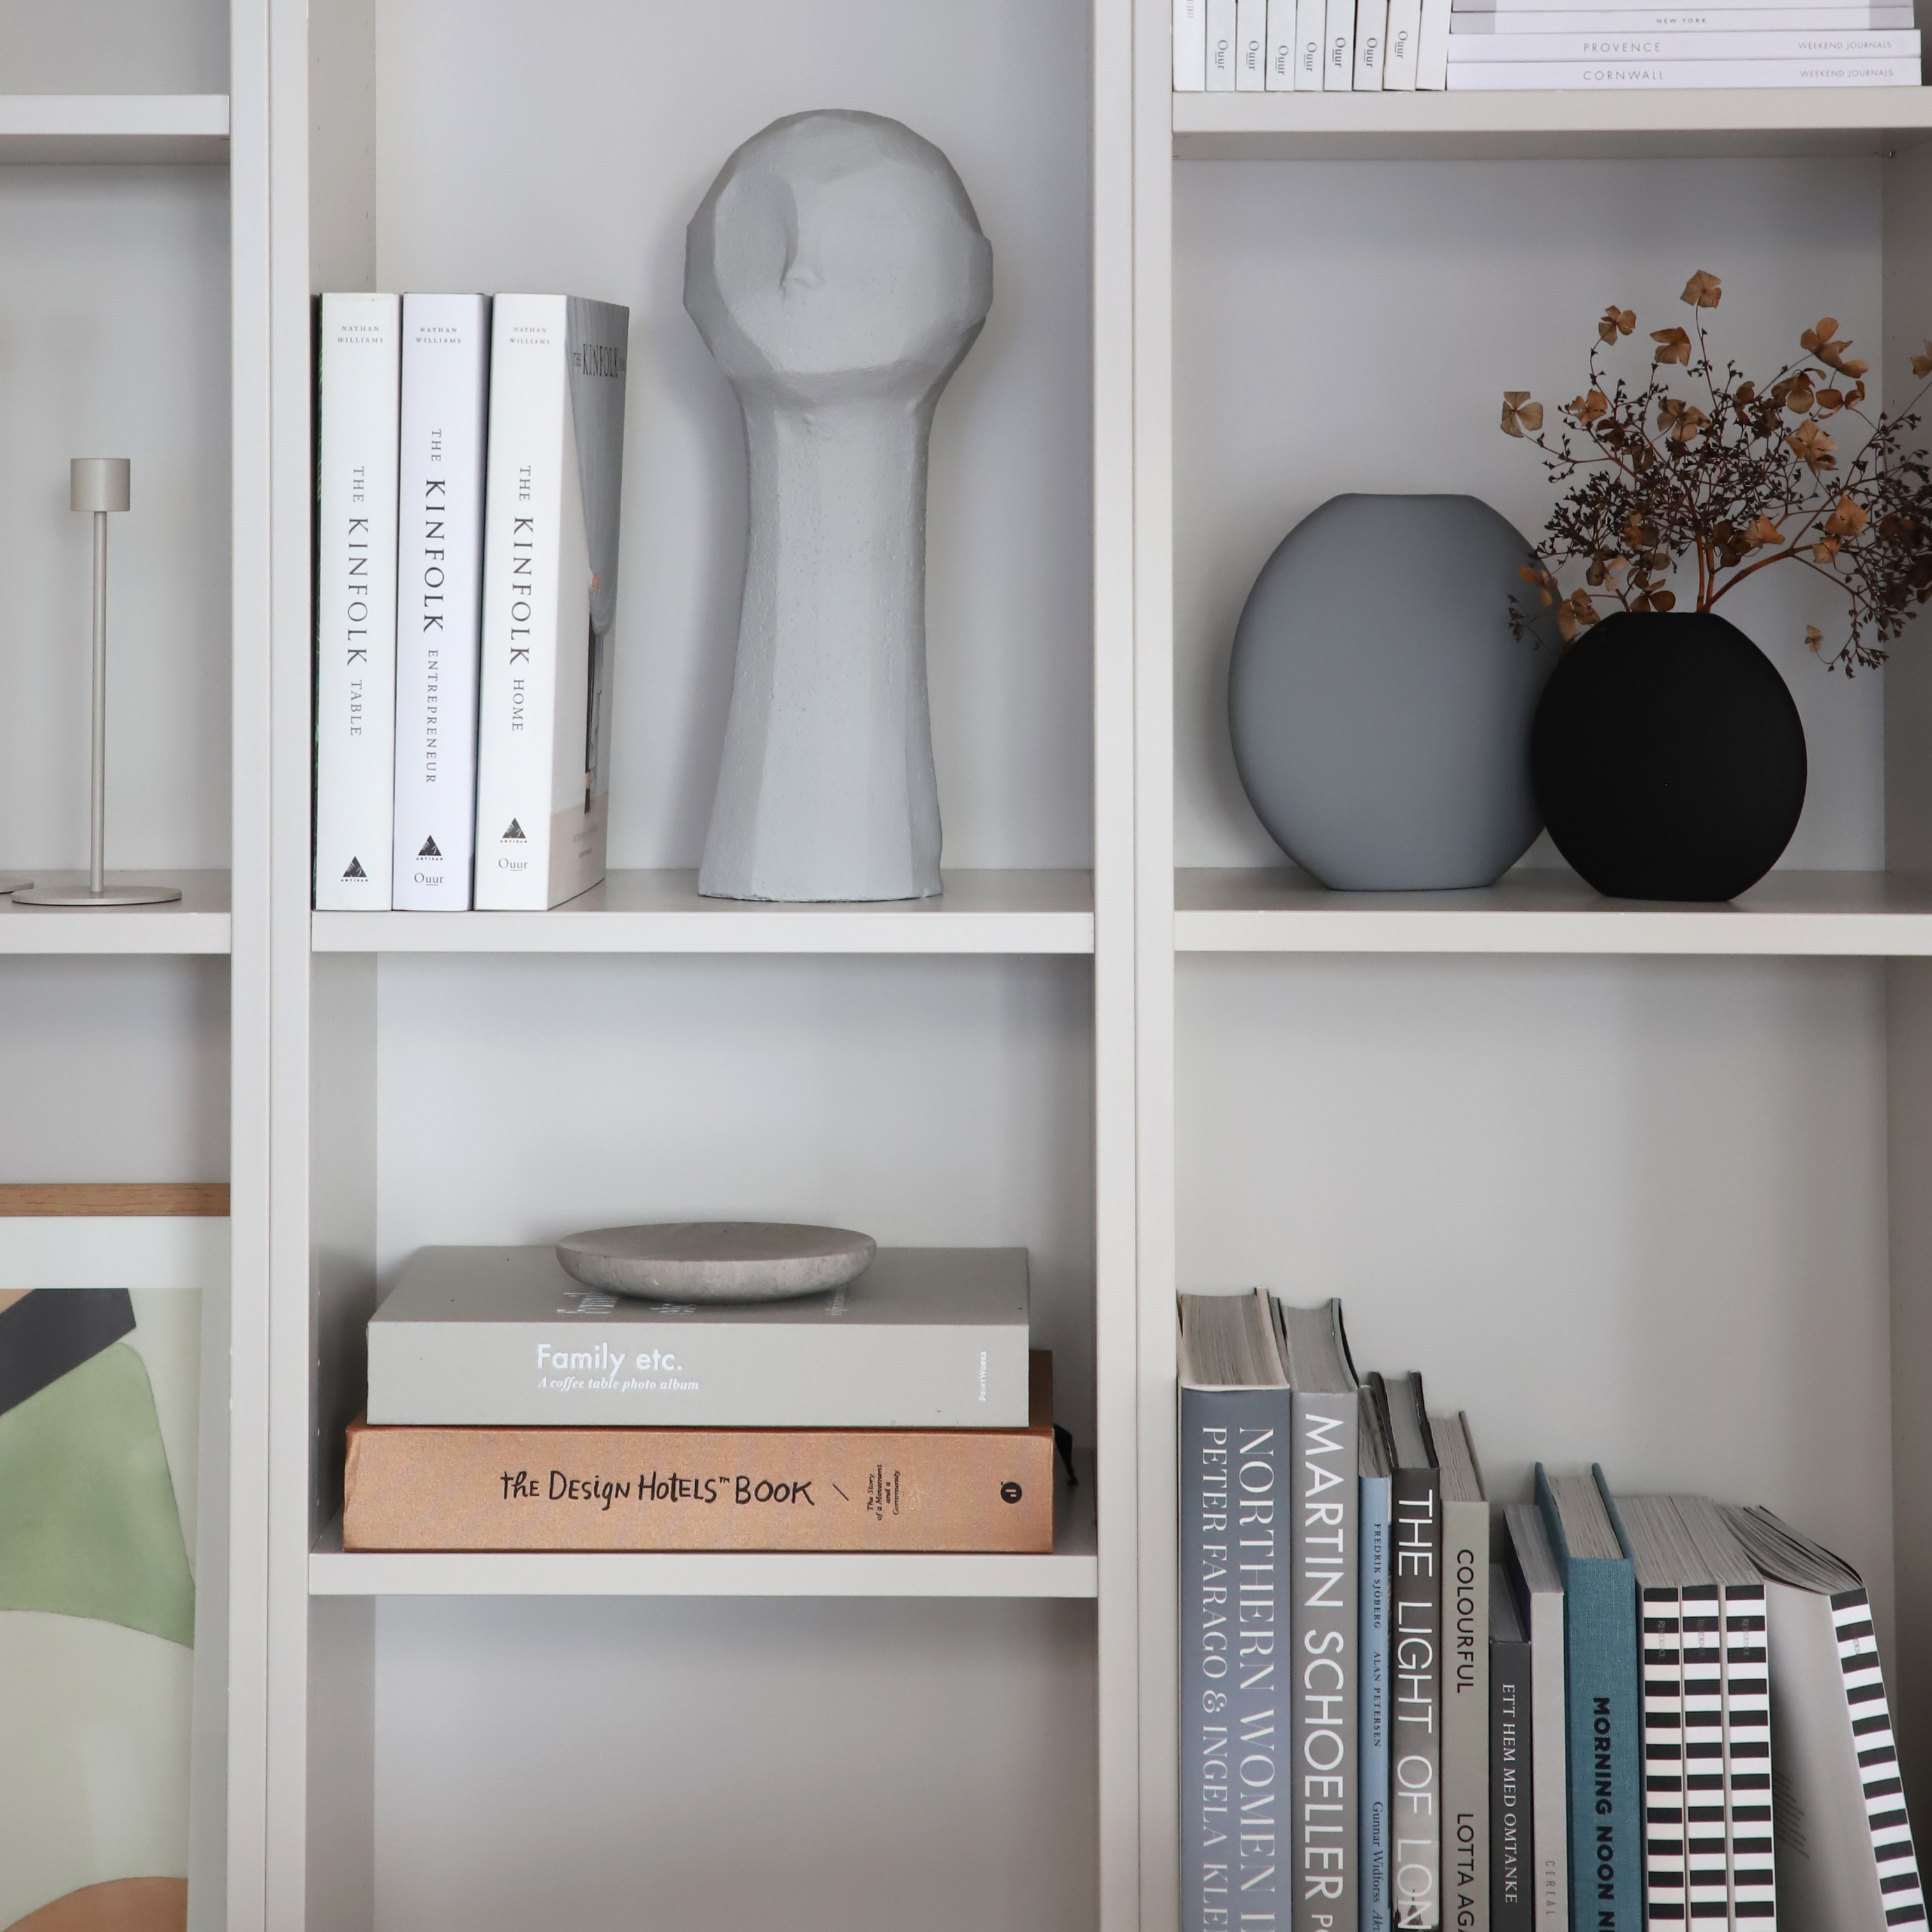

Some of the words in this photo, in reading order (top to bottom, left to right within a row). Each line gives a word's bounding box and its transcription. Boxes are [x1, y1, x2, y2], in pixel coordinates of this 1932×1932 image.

[1215, 40, 1228, 70] Ouur
[1246, 40, 1259, 70] Ouur
[1276, 45, 1289, 75] Ouur
[1304, 42, 1317, 73] Ouur
[1332, 37, 1346, 68] Ouur
[1364, 38, 1378, 68] Ouur
[1395, 31, 1409, 59] Ouur
[1584, 43, 1660, 52] PROVENCE
[1846, 41, 1892, 50] JOURNALS
[1583, 71, 1663, 80] CORNWALL
[1800, 69, 1845, 77] WEEKEND
[1848, 69, 1894, 77] JOURNALS
[583, 343, 618, 378] KINFOLK
[431, 429, 441, 461] THE
[353, 466, 364, 502] THE
[519, 466, 530, 500] THE
[422, 479, 446, 634] KINFOLK
[346, 517, 369, 667] KINFOLK
[509, 517, 535, 666] KINFOLK
[351, 680, 362, 736] TABLE
[426, 651, 438, 782] ENTREPRENEUR
[512, 679, 524, 731] HOME
[414, 873, 444, 886] Ouur
[498, 859, 528, 871] Ouur
[537, 1343, 626, 1377] Family
[636, 1349, 683, 1371] etc.
[538, 1378, 547, 1388] A
[550, 1377, 584, 1391] coffee
[588, 1377, 619, 1390] table
[622, 1379, 657, 1392] photo
[660, 1379, 699, 1390] album
[736, 1476, 815, 1506] BOOK
[1203, 1427, 1227, 1533] PETER
[876, 1513, 883, 1521] of
[1305, 1413, 1344, 1608] MARTIN
[1398, 1489, 1433, 1577] THE
[1240, 1427, 1275, 1693] NORTHERN
[1203, 1544, 1228, 1679] FARAGO
[1372, 1578, 1383, 1629] SJÖBERG
[1457, 1549, 1474, 1694] COLOURFUL
[1397, 1602, 1432, 1733] LIGHT
[1203, 1690, 1228, 1714] &
[1502, 1684, 1515, 1717] ETT
[1503, 1723, 1516, 1762] HEM
[1593, 1697, 1612, 1815] MORNING
[1304, 1629, 1344, 1901] SCHOELLER
[1397, 1755, 1432, 1815] OF
[1203, 1725, 1228, 1848] INGELA
[1240, 1709, 1275, 1893] WOMEN
[1503, 1767, 1517, 1807] MED
[1373, 1801, 1383, 1847] Gunnar
[1457, 1813, 1474, 1886] LOTTA
[1504, 1813, 1517, 1903] OMTANKE
[1596, 1826, 1614, 1900] NOON
[1373, 1851, 1384, 1903] Widforss
[1545, 1861, 1556, 1915] CEREAL
[1203, 1864, 1228, 1932] KLE
[1241, 1912, 1275, 1932] I
[1311, 1914, 1332, 1932] P
